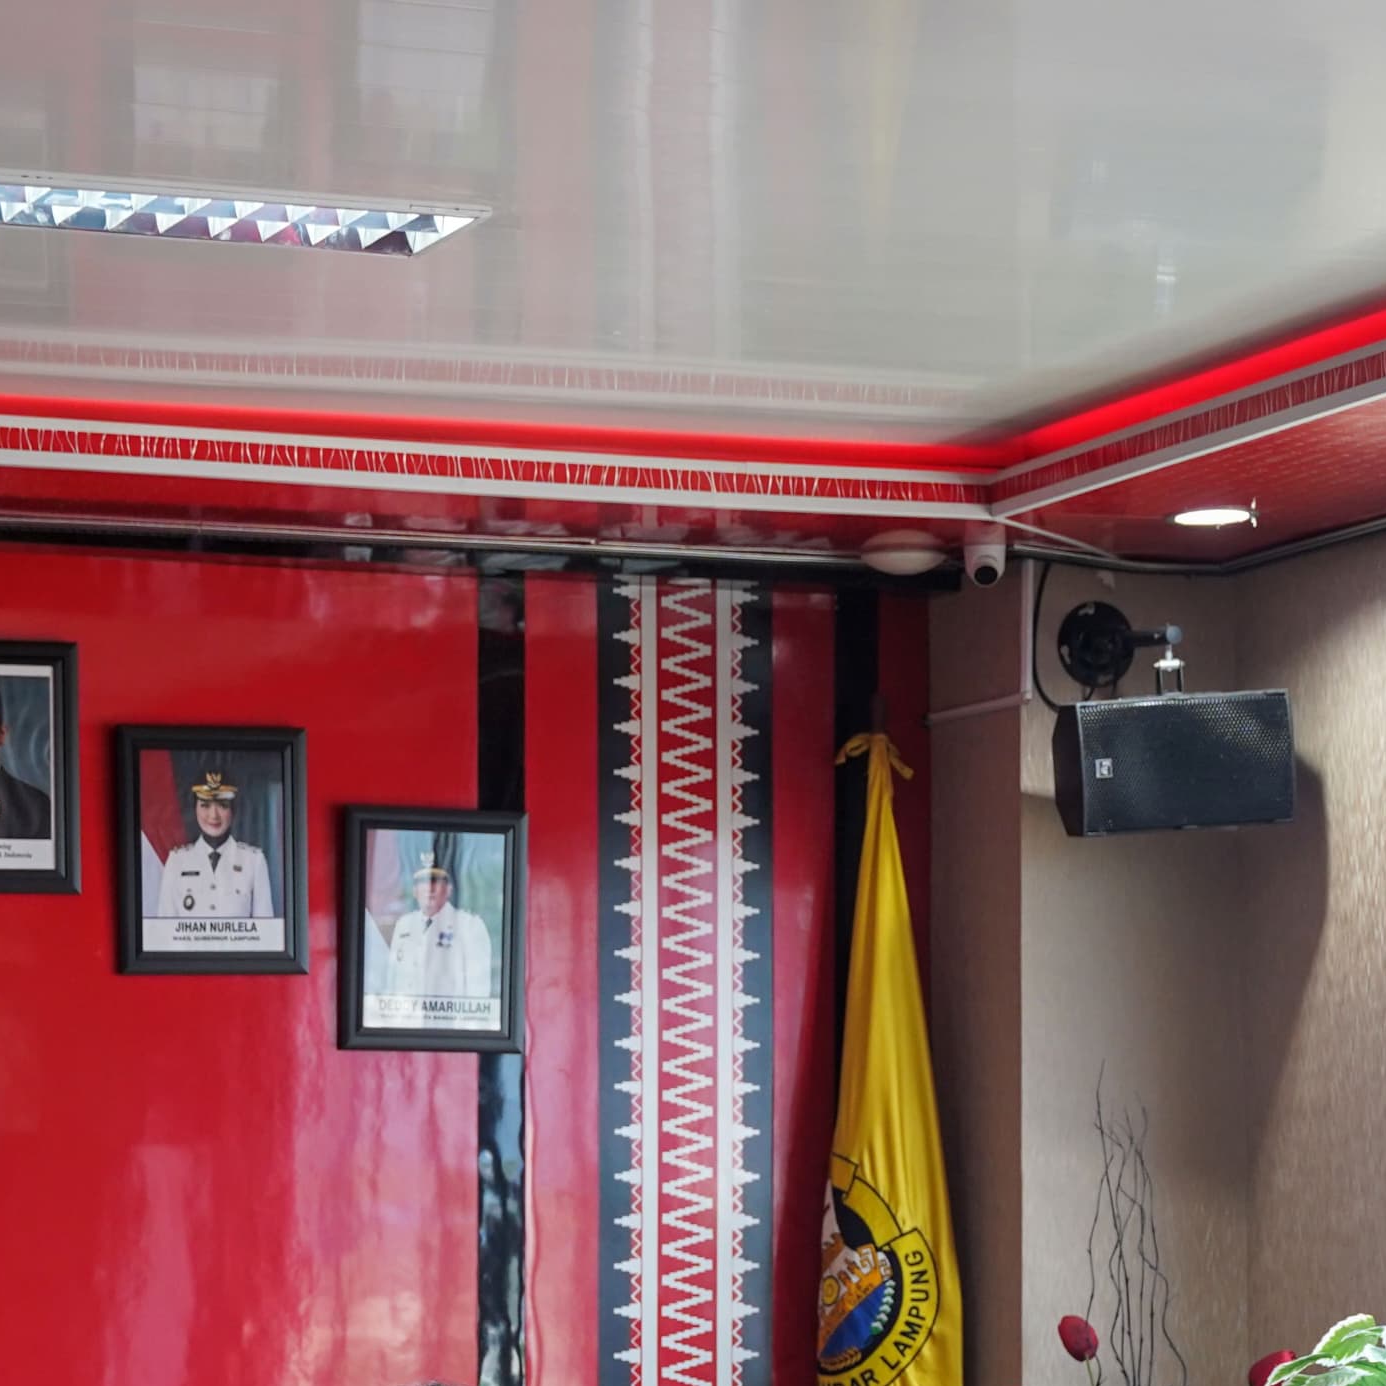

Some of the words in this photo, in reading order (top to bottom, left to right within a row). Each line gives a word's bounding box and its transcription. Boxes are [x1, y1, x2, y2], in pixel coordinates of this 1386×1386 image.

[175, 922, 207, 933] JIHAN
[210, 922, 258, 933] NURLELA
[421, 1000, 491, 1014] AMARULLAH
[880, 1250, 930, 1371] LAMPUNG
